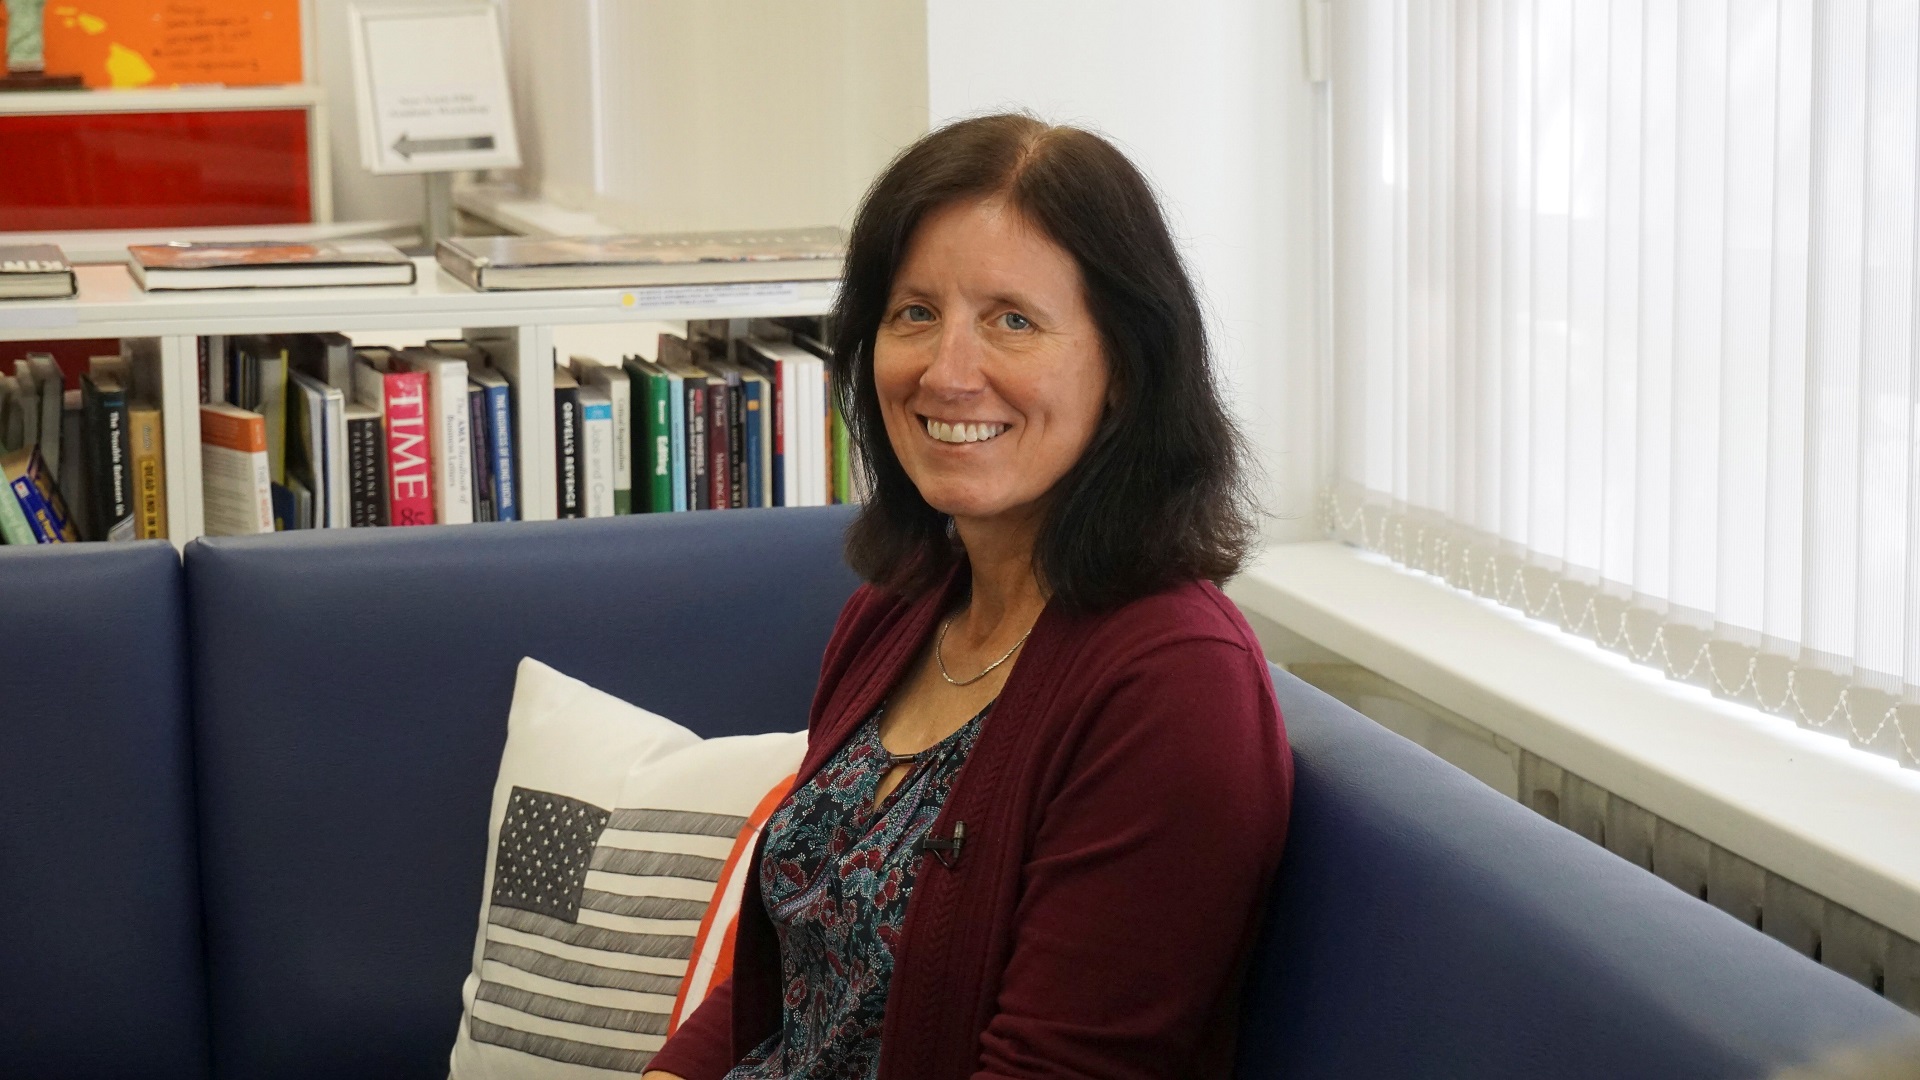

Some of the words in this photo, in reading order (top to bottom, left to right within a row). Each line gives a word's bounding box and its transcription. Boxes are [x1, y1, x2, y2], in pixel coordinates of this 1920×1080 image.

[109, 411, 120, 429] The
[562, 402, 575, 454] ORWELL'S
[111, 430, 122, 463] Trouble
[389, 383, 429, 501] TIME
[656, 436, 669, 475] Editing
[113, 464, 123, 503] Between
[565, 456, 576, 508] REVENGE
